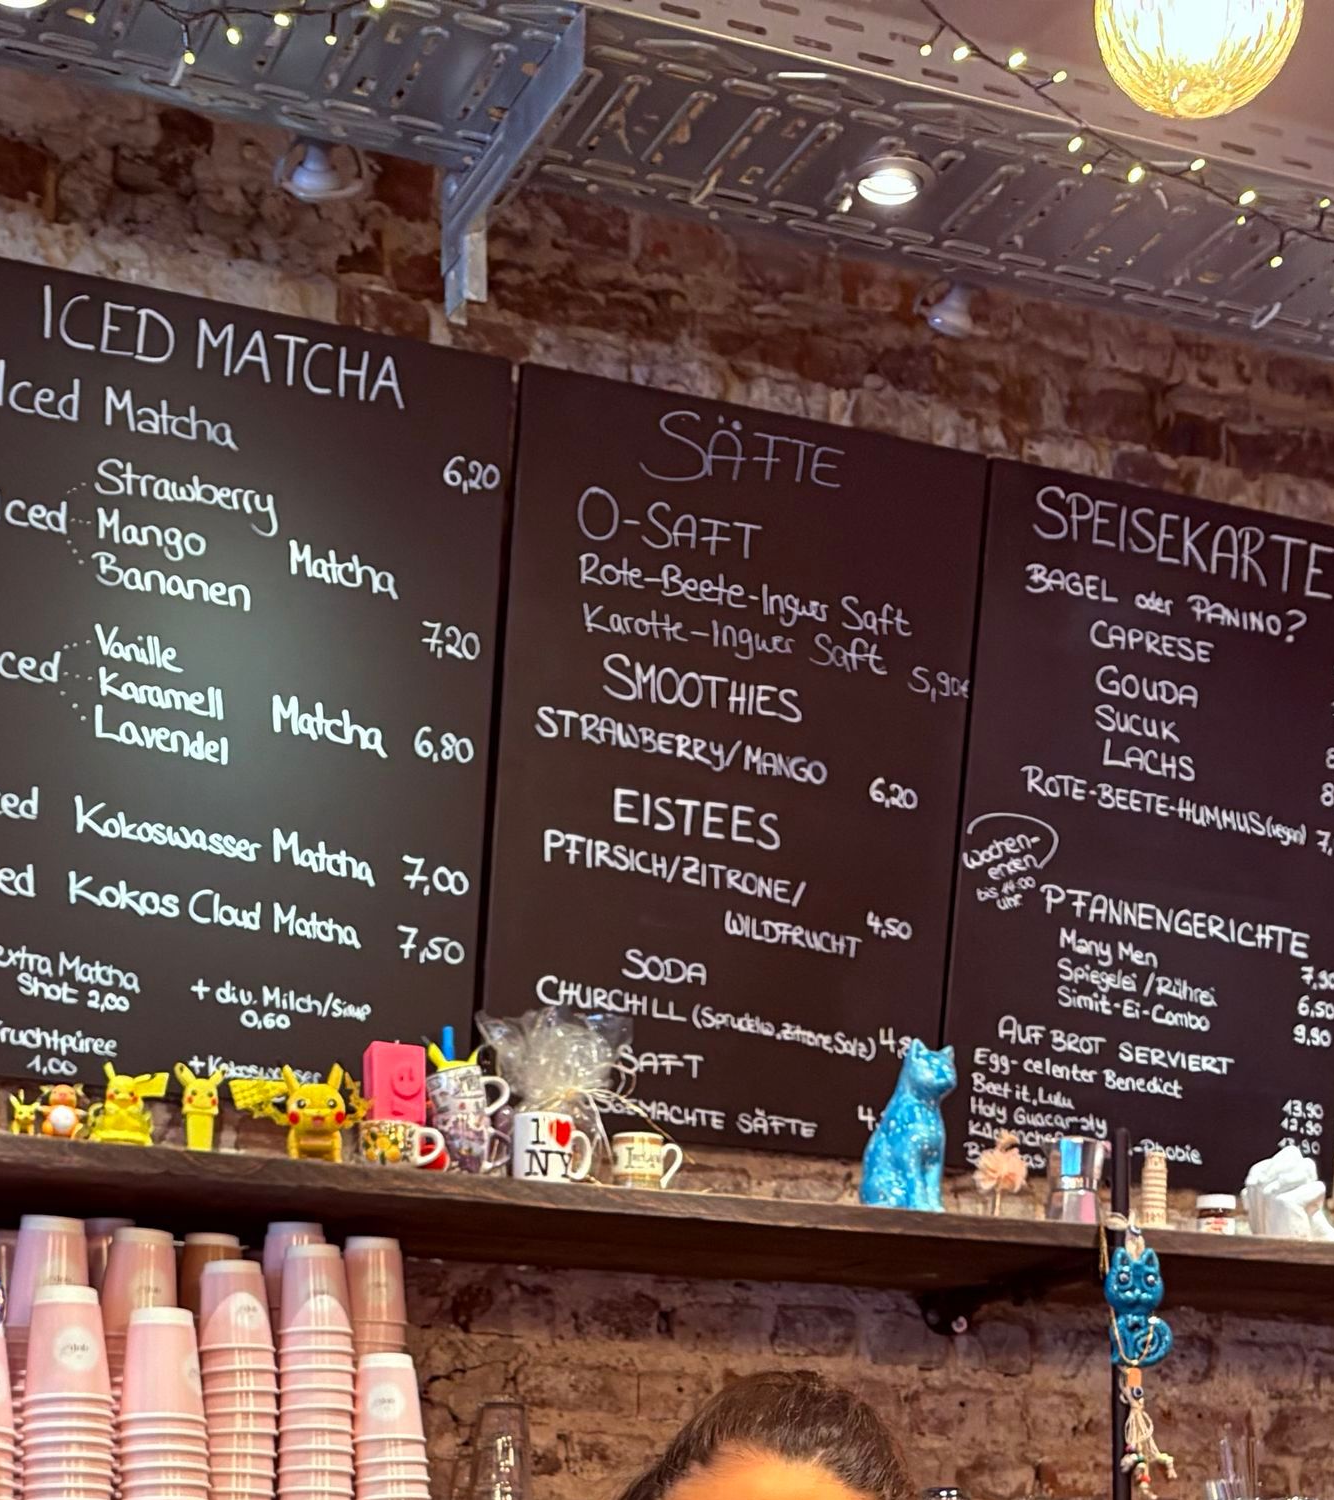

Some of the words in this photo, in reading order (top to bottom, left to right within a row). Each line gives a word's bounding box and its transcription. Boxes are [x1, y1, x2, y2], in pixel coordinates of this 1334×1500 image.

[43, 284, 175, 364] ICED
[196, 317, 406, 411] MATCHA
[104, 385, 240, 453] Matcha
[442, 455, 501, 494] 6,20
[639, 409, 846, 488] SÄFTE
[94, 458, 280, 539] Strawberry
[577, 486, 763, 559] O-SAFT
[92, 551, 252, 613] Bananen
[96, 506, 208, 562] Mango
[289, 539, 399, 602] Matcha
[421, 620, 481, 661] 7,20
[1025, 563, 1119, 603] BAGEL
[1135, 591, 1173, 617] oder
[840, 596, 915, 637] Saft
[1090, 620, 1215, 664] CAPRESE
[94, 623, 184, 674] Vanille
[809, 633, 888, 676] Saft
[603, 652, 803, 723] SMOOTHIES
[1095, 664, 1199, 709] GOUDA
[94, 704, 229, 766] Lavendel
[98, 666, 225, 721] Karamell
[272, 694, 388, 759] Matcha
[413, 726, 475, 764] 6,80
[1095, 704, 1181, 744] SUCUK
[1102, 738, 1196, 782] LACHS
[869, 776, 918, 810] 6,20
[74, 794, 263, 864] Kokoswasser
[272, 827, 376, 888] Matcha
[402, 855, 469, 896] 7,00
[613, 788, 782, 851] EISTEES
[68, 870, 180, 919] Kokos
[187, 888, 262, 933] Cloud
[273, 902, 362, 950] Matcha
[396, 924, 466, 966] 7,50
[724, 911, 862, 958] WILDFRUCHT
[866, 911, 913, 941] 4,50
[1039, 884, 1311, 959] PFANNENGERICHTE
[58, 944, 141, 995] Matcha
[621, 949, 707, 986] SODA
[1059, 927, 1113, 965] Many
[1118, 941, 1158, 968] Men
[17, 970, 78, 1004] Shot
[86, 989, 131, 1013] 2,00
[536, 975, 686, 1022] CHURCHILL
[618, 1044, 704, 1078] SAFT
[997, 1015, 1045, 1046] AUF
[1051, 1028, 1106, 1056] BROT
[1118, 1042, 1235, 1076] SERVIERT
[1103, 1069, 1182, 1099] Benedict
[736, 1108, 818, 1139] SÄFTE
